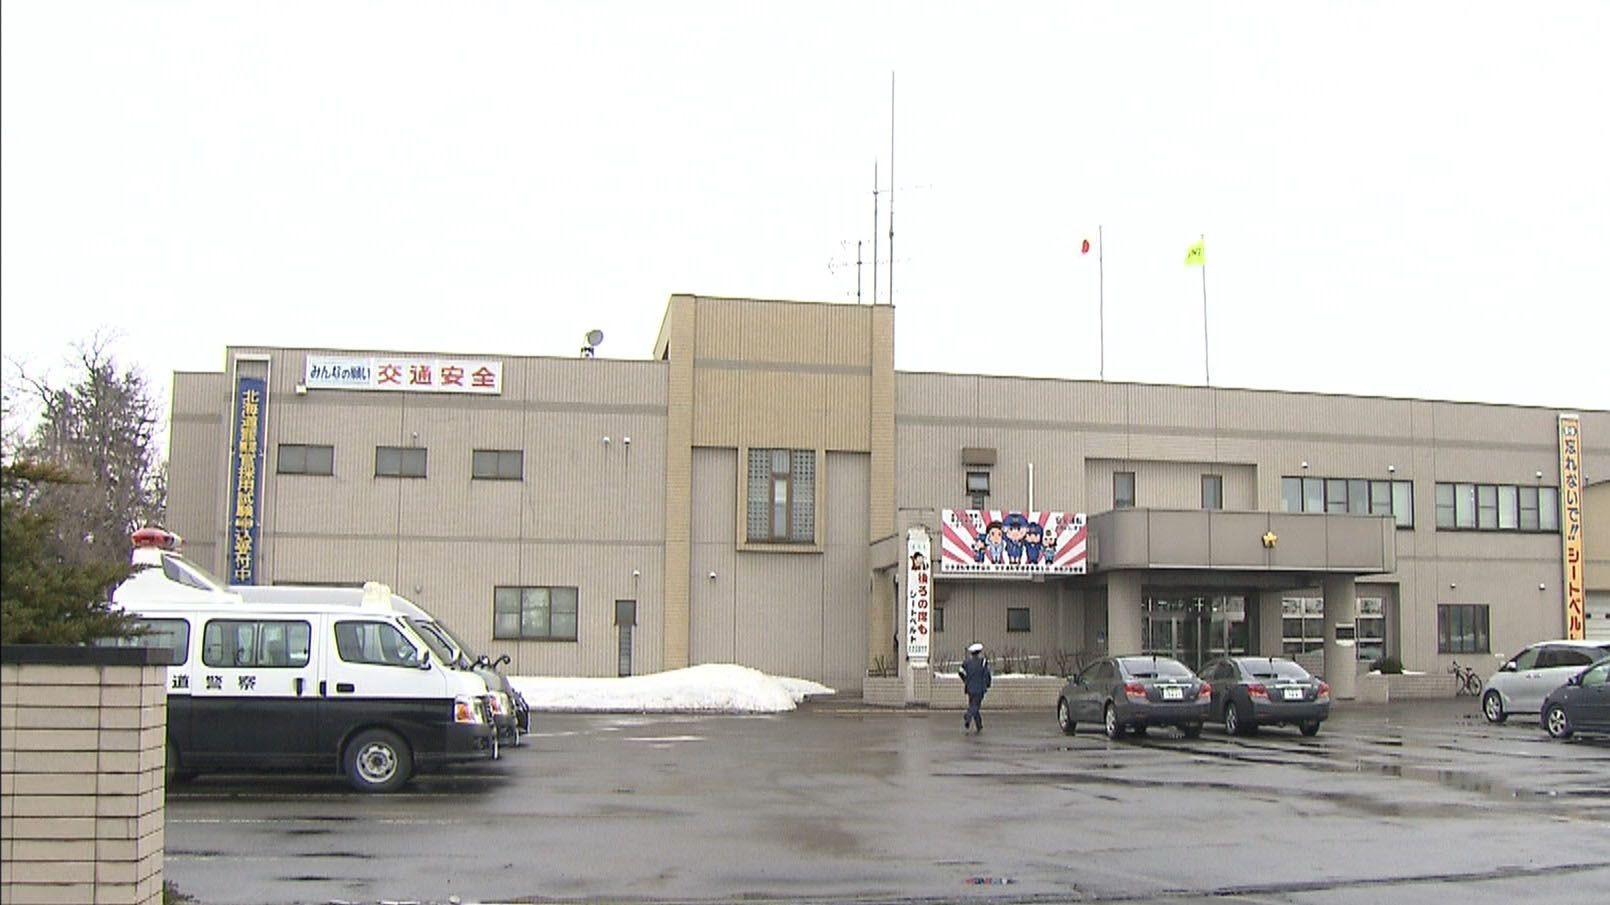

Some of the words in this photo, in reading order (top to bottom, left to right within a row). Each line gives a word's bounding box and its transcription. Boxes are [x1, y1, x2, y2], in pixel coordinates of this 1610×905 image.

[310, 365, 371, 380] みんなの願い
[377, 363, 496, 388] 交通安全
[172, 675, 256, 690] 道警察
